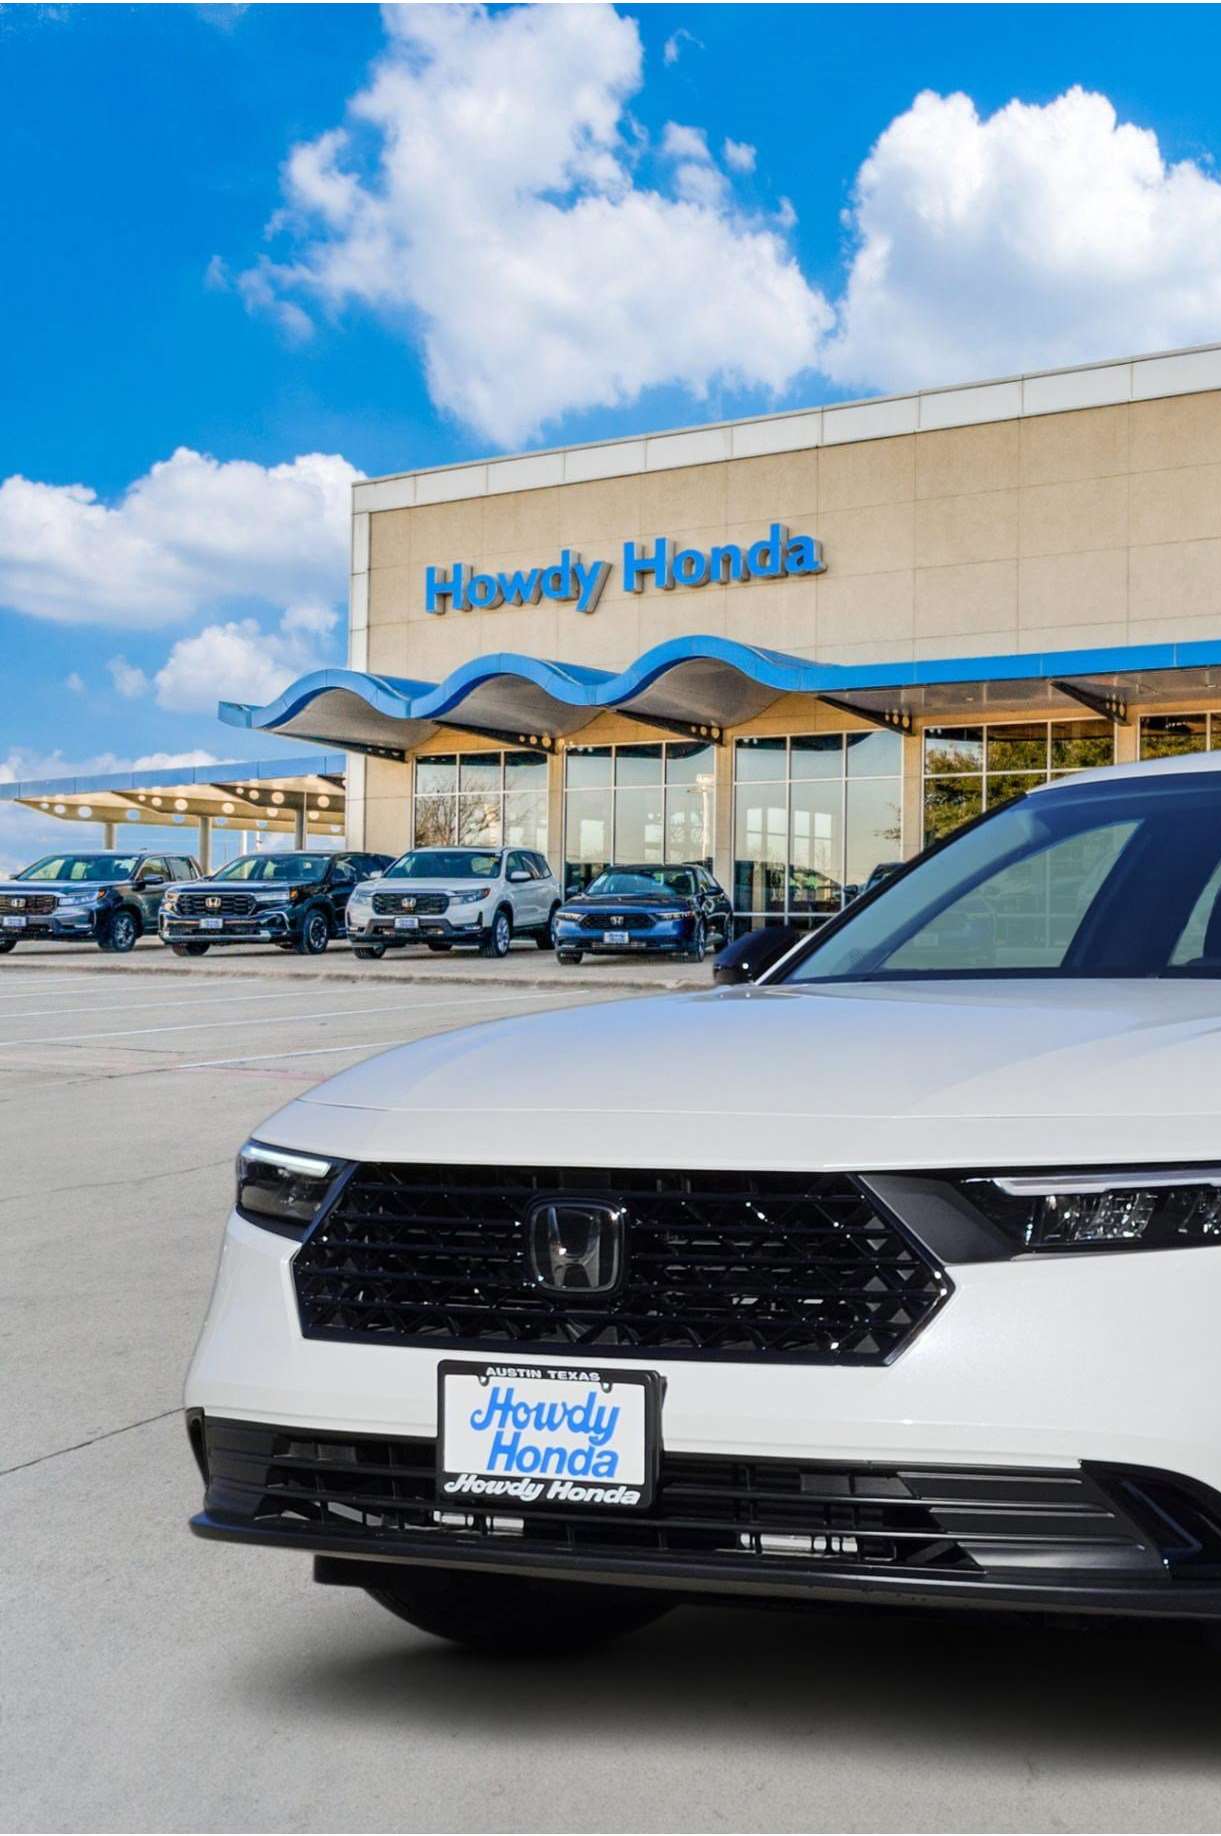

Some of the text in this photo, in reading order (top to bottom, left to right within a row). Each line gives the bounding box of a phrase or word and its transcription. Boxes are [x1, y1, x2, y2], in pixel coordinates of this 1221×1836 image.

[425, 523, 826, 614] Howdy Honda
[486, 1367, 601, 1381] AUSTIN TEXAS
[470, 1387, 620, 1445] Howdy
[486, 1431, 618, 1478] Honda
[444, 1474, 640, 1505] Howdy Honda
